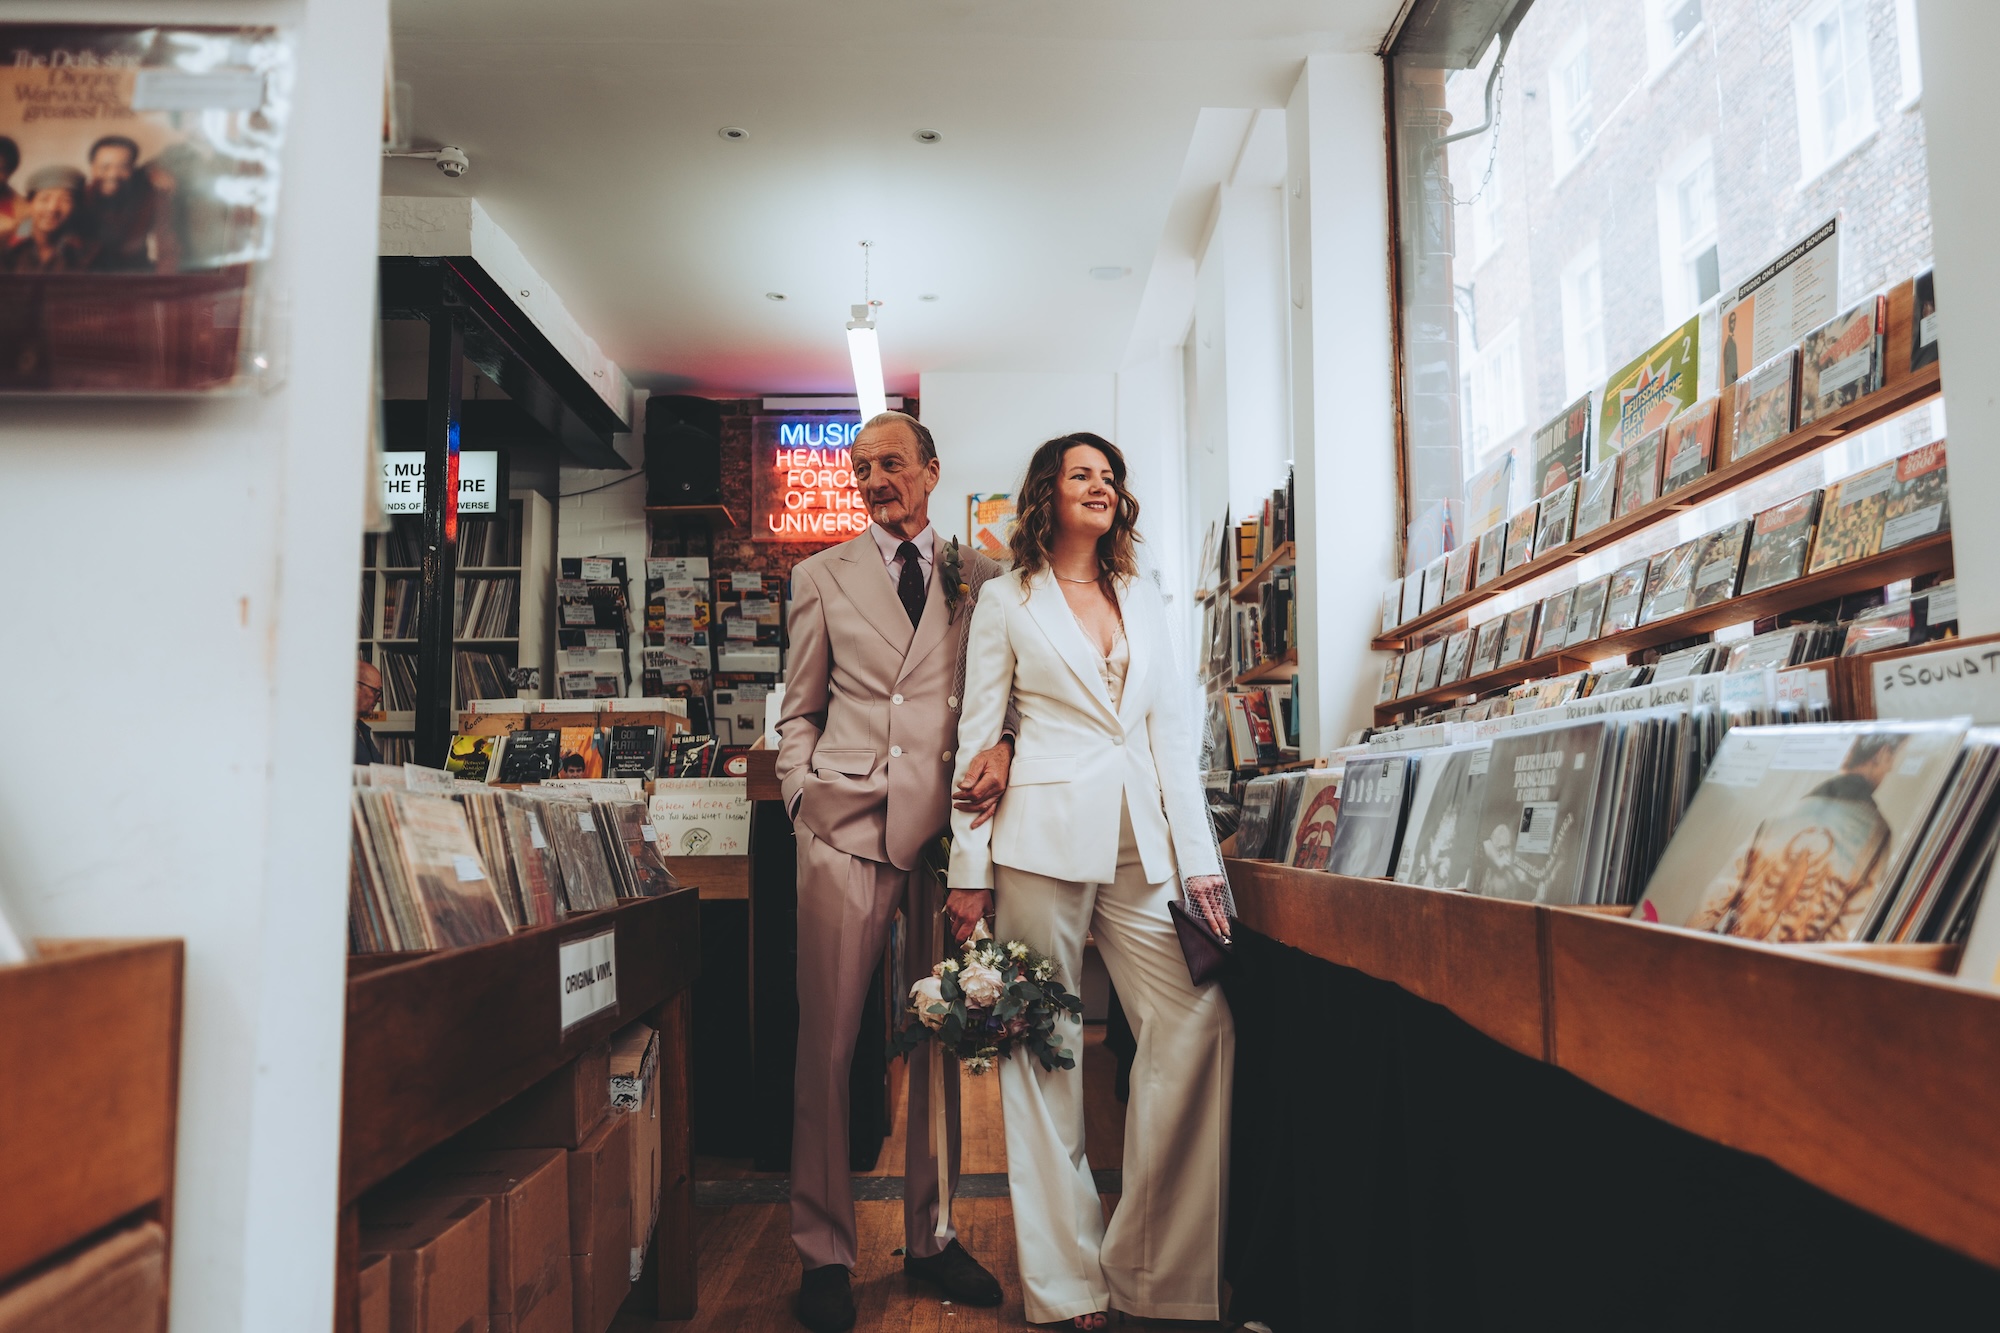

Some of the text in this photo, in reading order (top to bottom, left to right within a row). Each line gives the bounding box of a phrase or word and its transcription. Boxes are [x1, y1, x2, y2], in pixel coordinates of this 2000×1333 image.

[1739, 222, 1835, 298] STUDIO ONE FREEDOM SOUNDS
[1681, 335, 1691, 364] 2
[1904, 454, 1936, 475] 2000
[408, 502, 421, 511] OF
[785, 490, 866, 510] OF THE
[672, 734, 711, 745] THE HARD STUFF
[708, 780, 735, 788] DISCO
[565, 960, 613, 995] ORIGINAL VINYL
